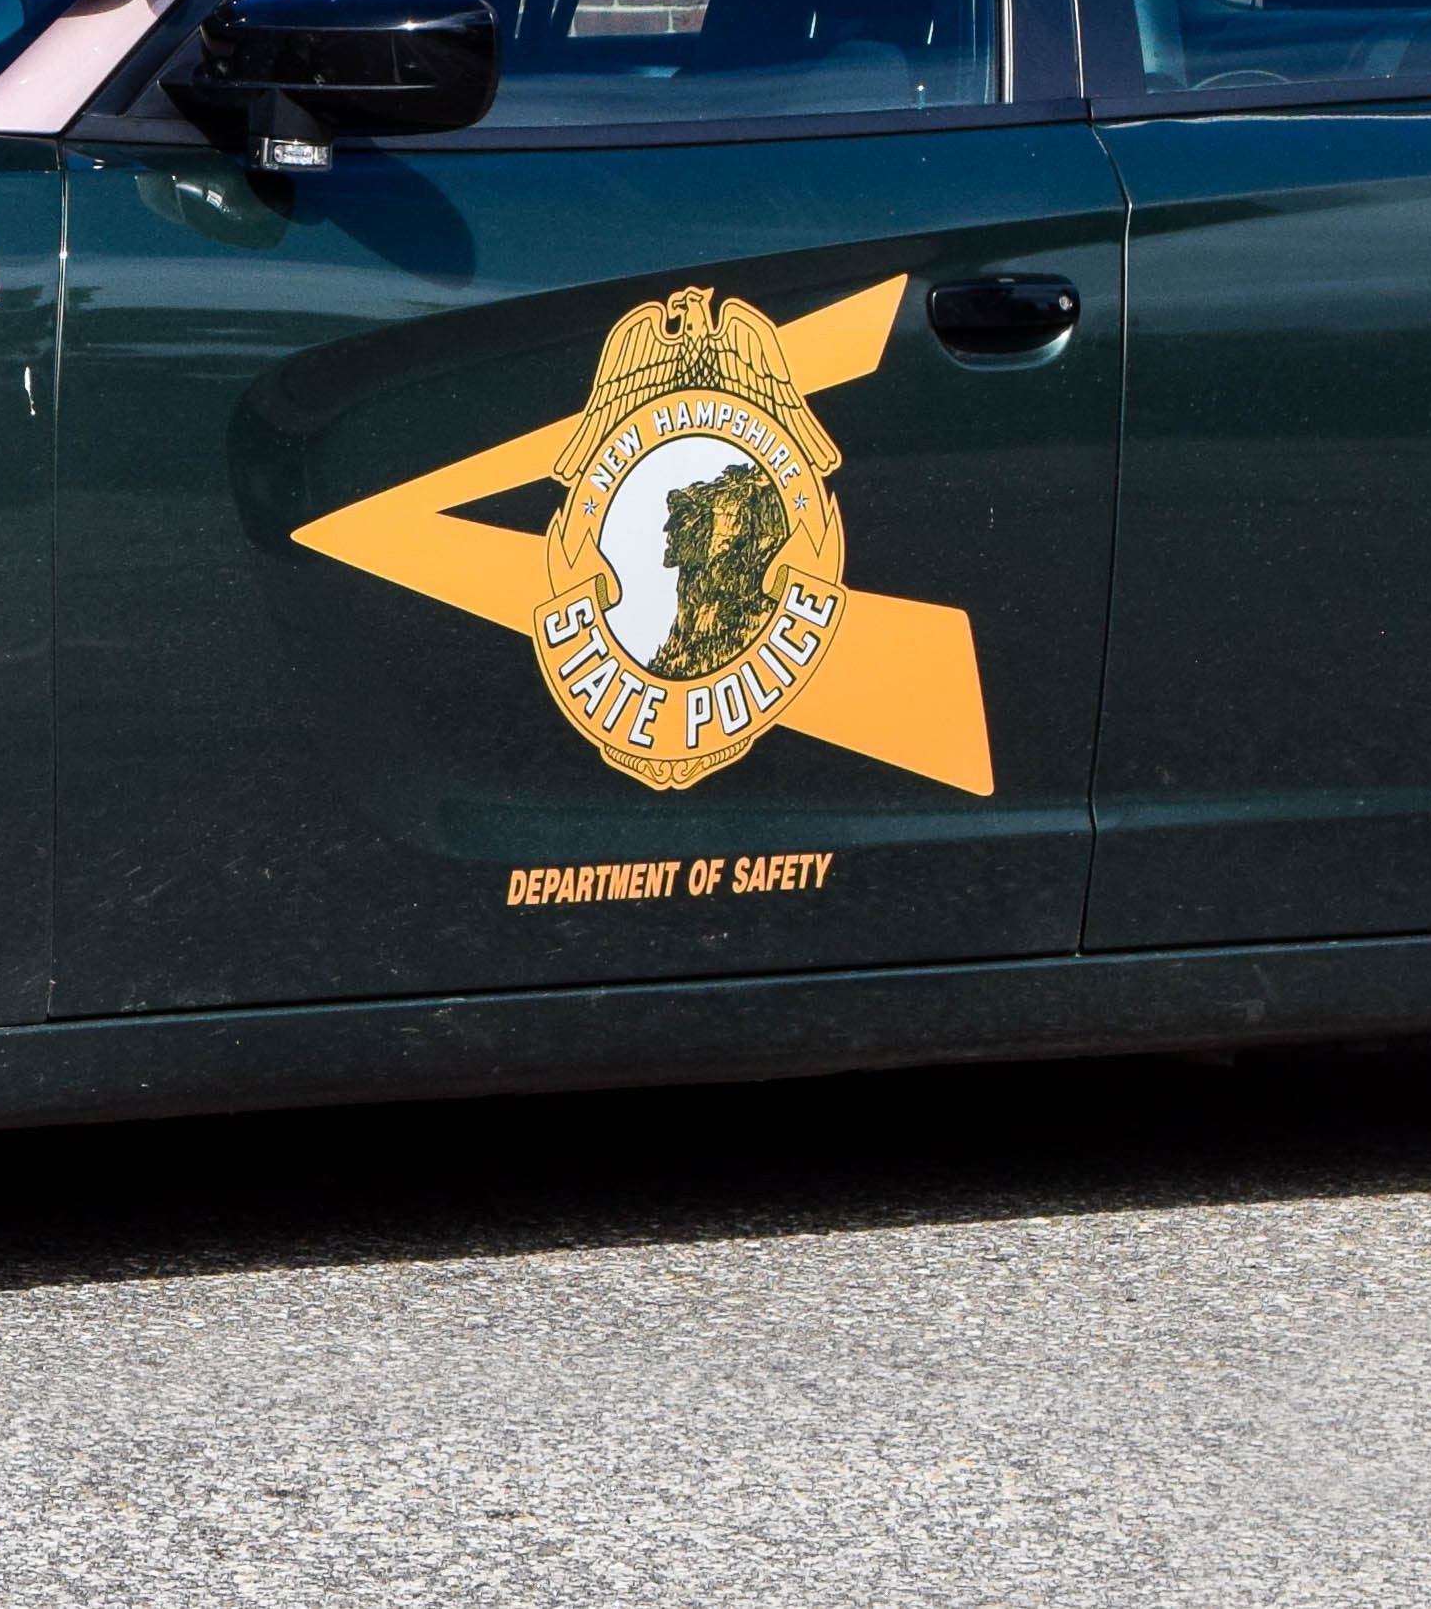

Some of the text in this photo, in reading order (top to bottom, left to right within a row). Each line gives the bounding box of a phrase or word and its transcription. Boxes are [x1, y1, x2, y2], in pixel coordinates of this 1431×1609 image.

[589, 400, 805, 494] NEW HAMPSHIRE
[543, 583, 837, 749] STATE POLICE
[507, 852, 833, 906] DEPARTMENT OF SAFETY
